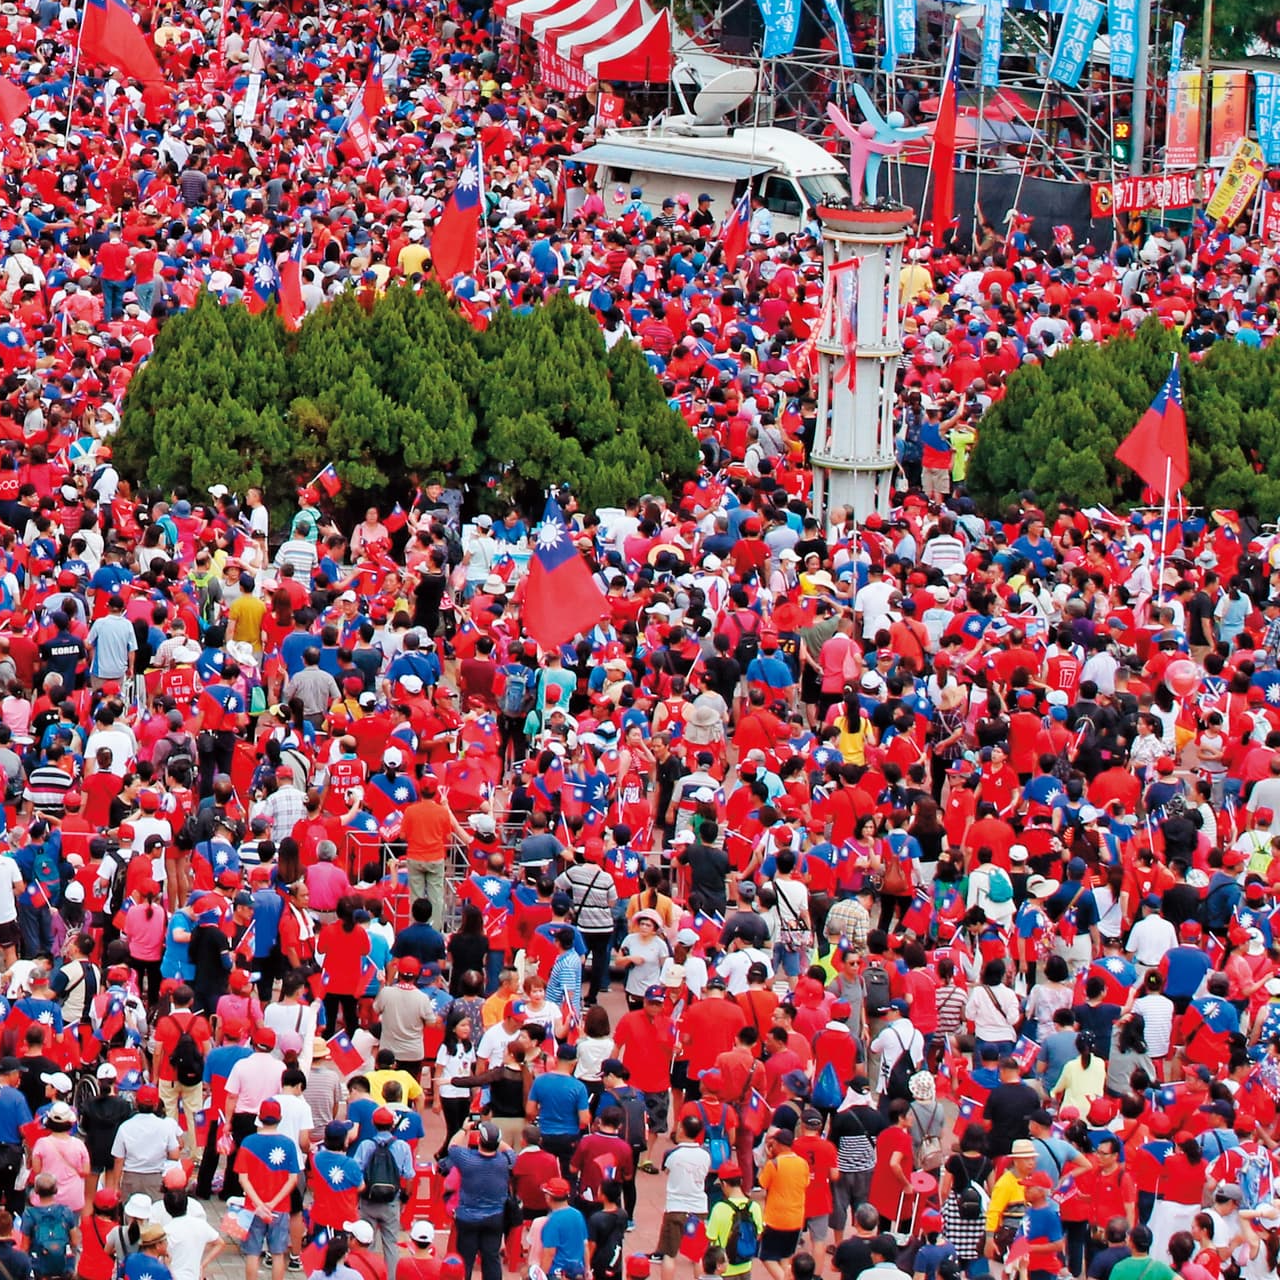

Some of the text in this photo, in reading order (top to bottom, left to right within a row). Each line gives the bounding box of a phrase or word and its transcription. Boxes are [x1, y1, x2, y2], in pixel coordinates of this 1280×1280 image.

[1115, 122, 1129, 138] 32
[51, 644, 80, 656] KOREA
[1058, 668, 1076, 689] 17
